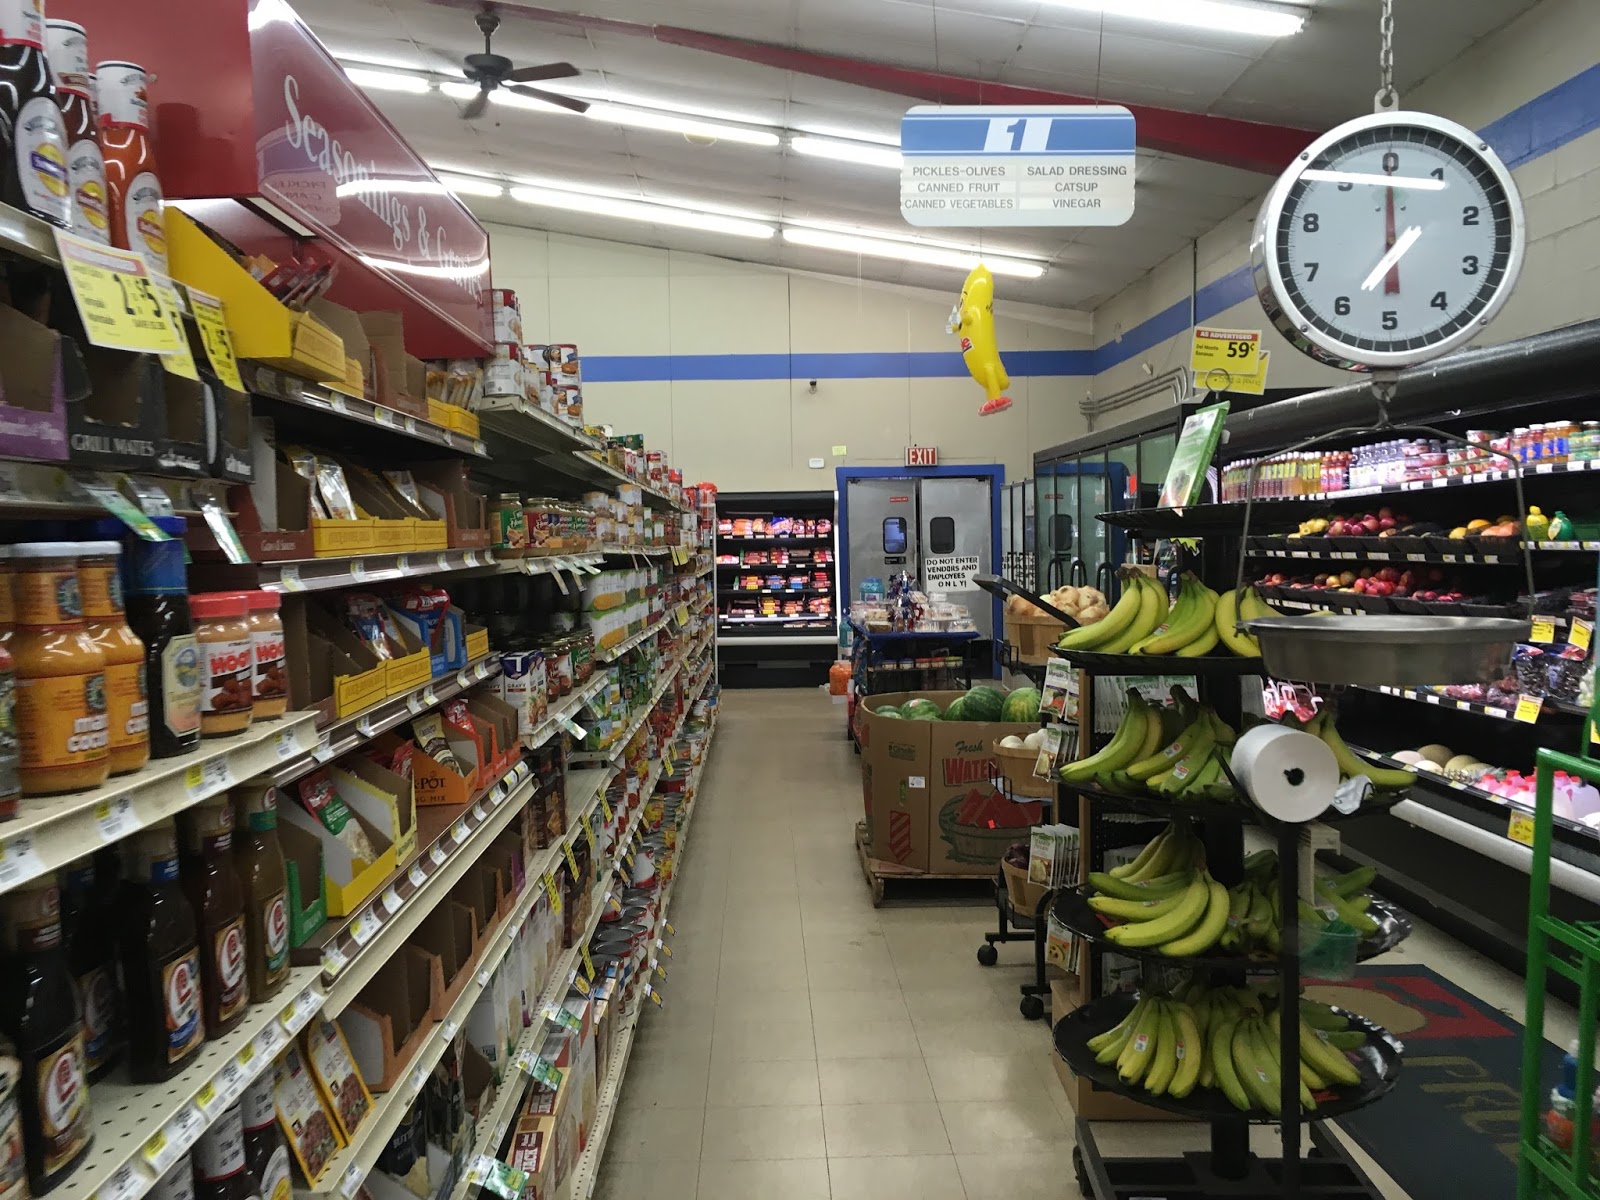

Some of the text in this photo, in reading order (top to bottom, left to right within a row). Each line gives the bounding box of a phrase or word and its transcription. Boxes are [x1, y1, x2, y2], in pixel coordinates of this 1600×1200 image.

[1006, 118, 1027, 151] 1
[1027, 165, 1127, 176] SALAD DRESSING
[1382, 153, 1399, 173] 0
[912, 166, 1006, 177] PICKLES-OLIVES
[917, 182, 1001, 193] CANNED FRUIT
[1054, 182, 1098, 192] CATSUP
[904, 199, 1013, 209] CANNED VEGETABLES
[1052, 198, 1101, 208] VINEGAR
[1303, 213, 1319, 233] 8
[1462, 206, 1479, 226] 2
[1303, 262, 1319, 282] 7
[1462, 255, 1479, 275] 3
[1334, 296, 1351, 316] 6
[1430, 291, 1448, 311] 4
[1382, 311, 1398, 331] 5
[1209, 332, 1253, 340] ADVERTISED
[909, 448, 933, 465] EXIT
[927, 565, 960, 573] VENDORS
[928, 572, 966, 580] EMPLOYEES
[955, 740, 984, 755] Fresh
